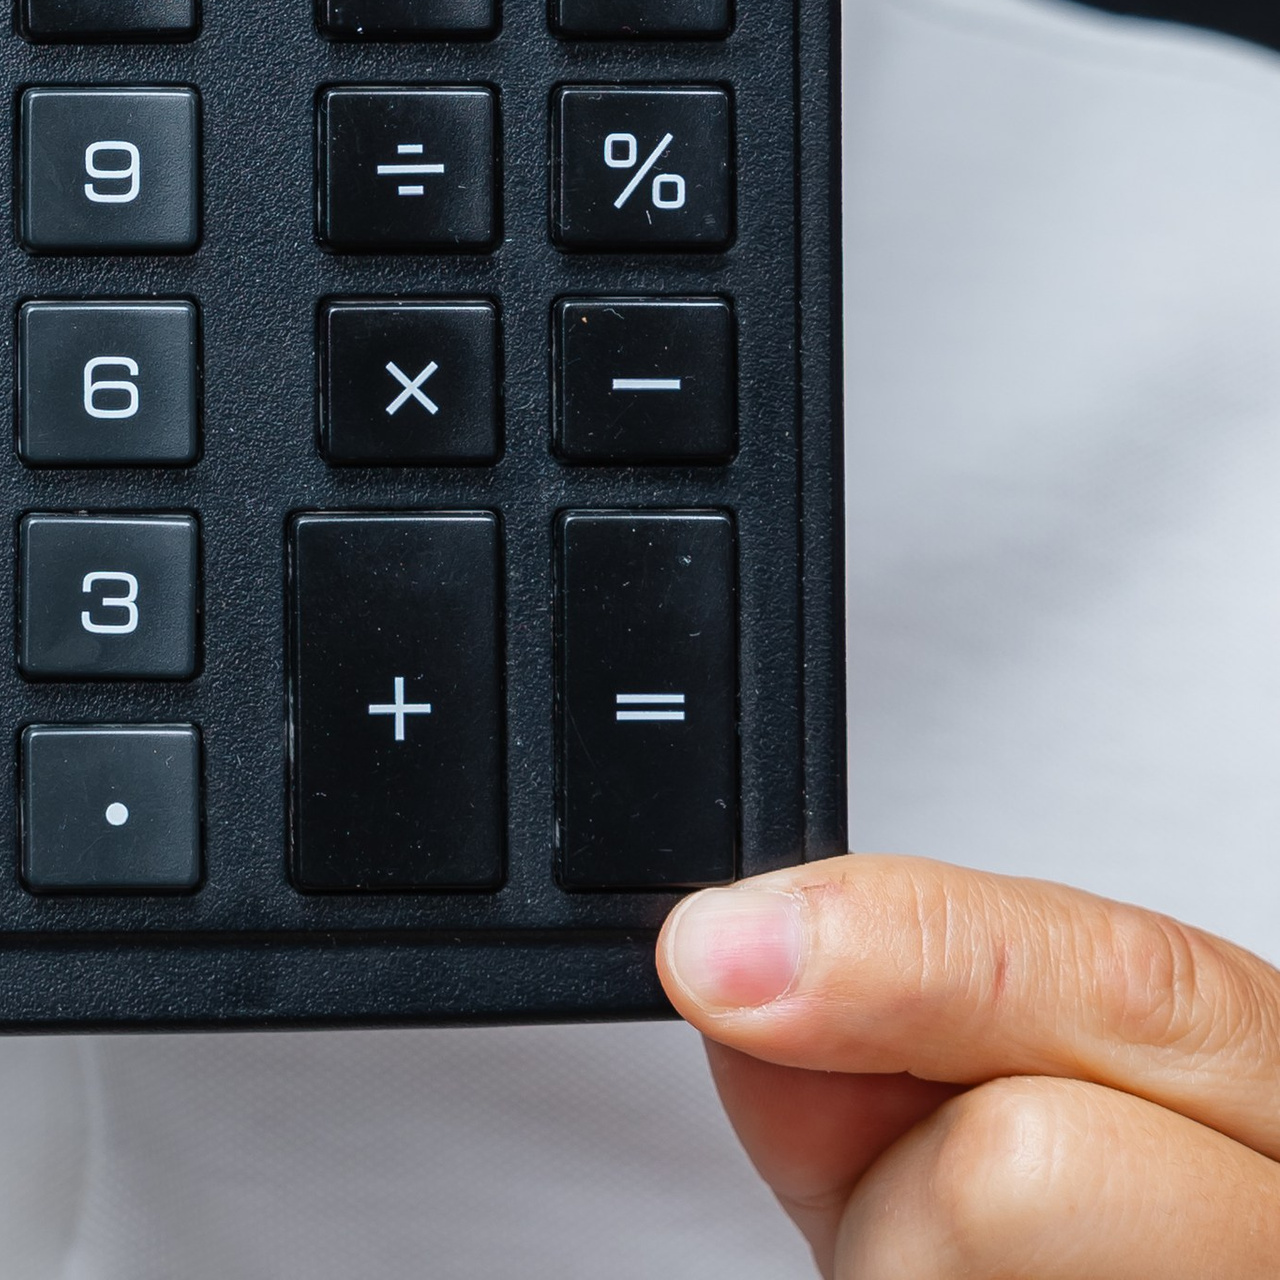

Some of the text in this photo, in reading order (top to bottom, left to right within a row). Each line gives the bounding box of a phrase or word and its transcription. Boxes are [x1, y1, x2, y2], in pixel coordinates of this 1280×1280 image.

[84, 140, 141, 204] 9
[83, 356, 139, 419] 6
[81, 571, 139, 634] 3
